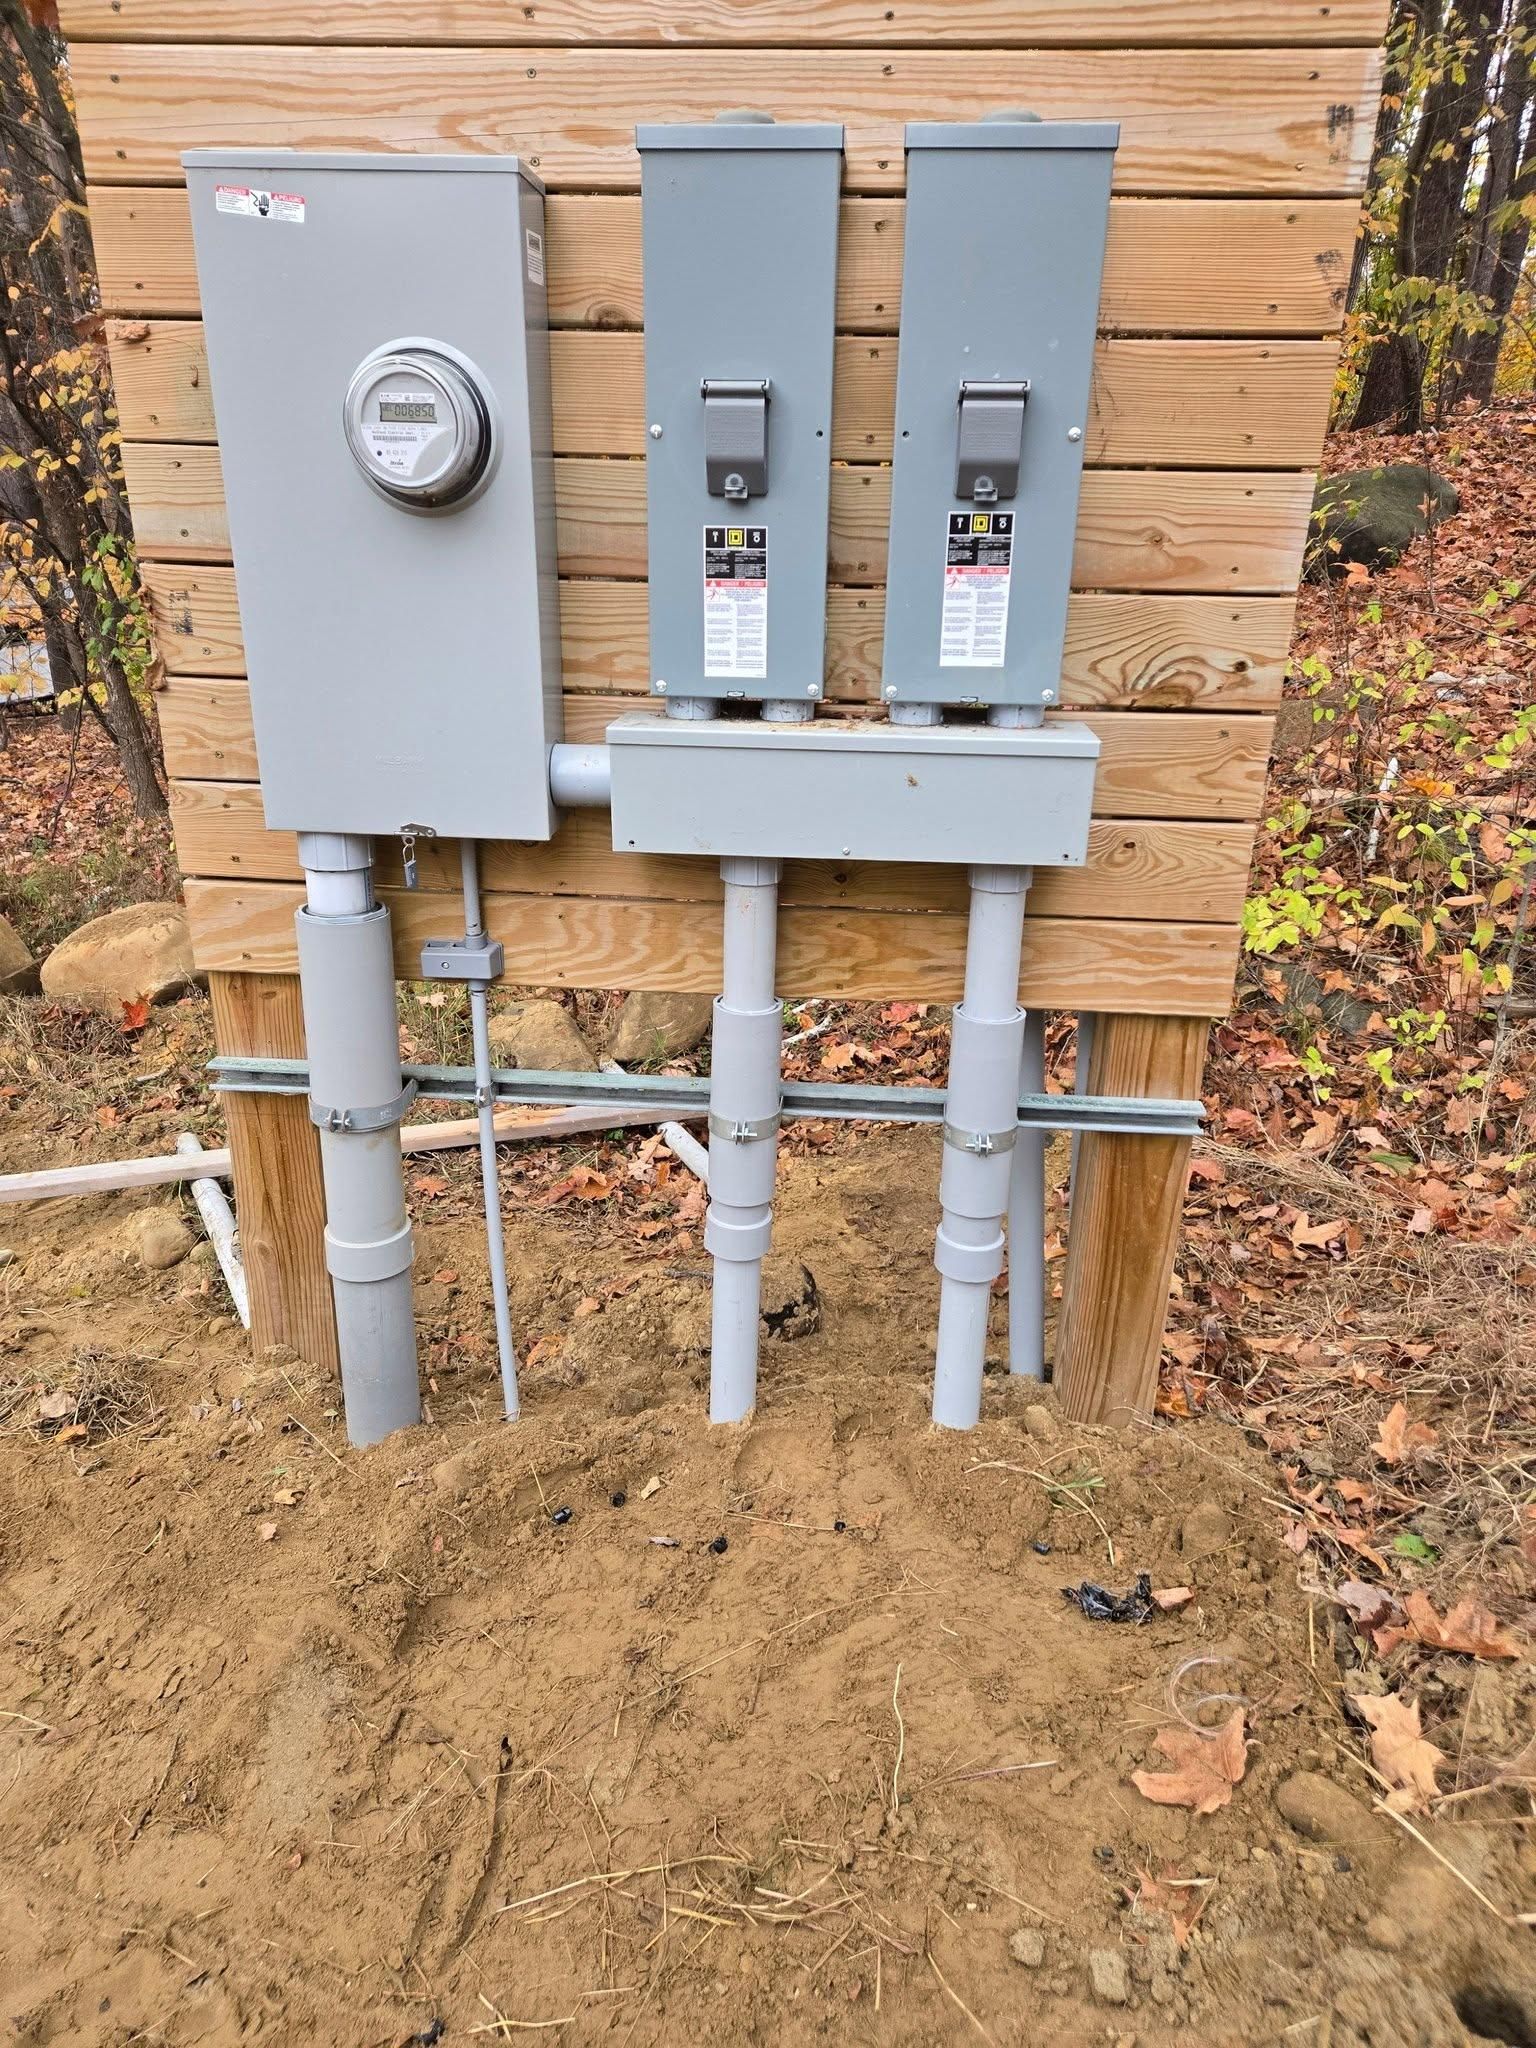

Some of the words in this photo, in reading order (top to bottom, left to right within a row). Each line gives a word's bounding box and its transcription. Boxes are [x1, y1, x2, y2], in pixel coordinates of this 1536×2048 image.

[223, 186, 246, 195] DANGER
[279, 194, 302, 203] PELIGRO
[395, 404, 434, 417] 006850
